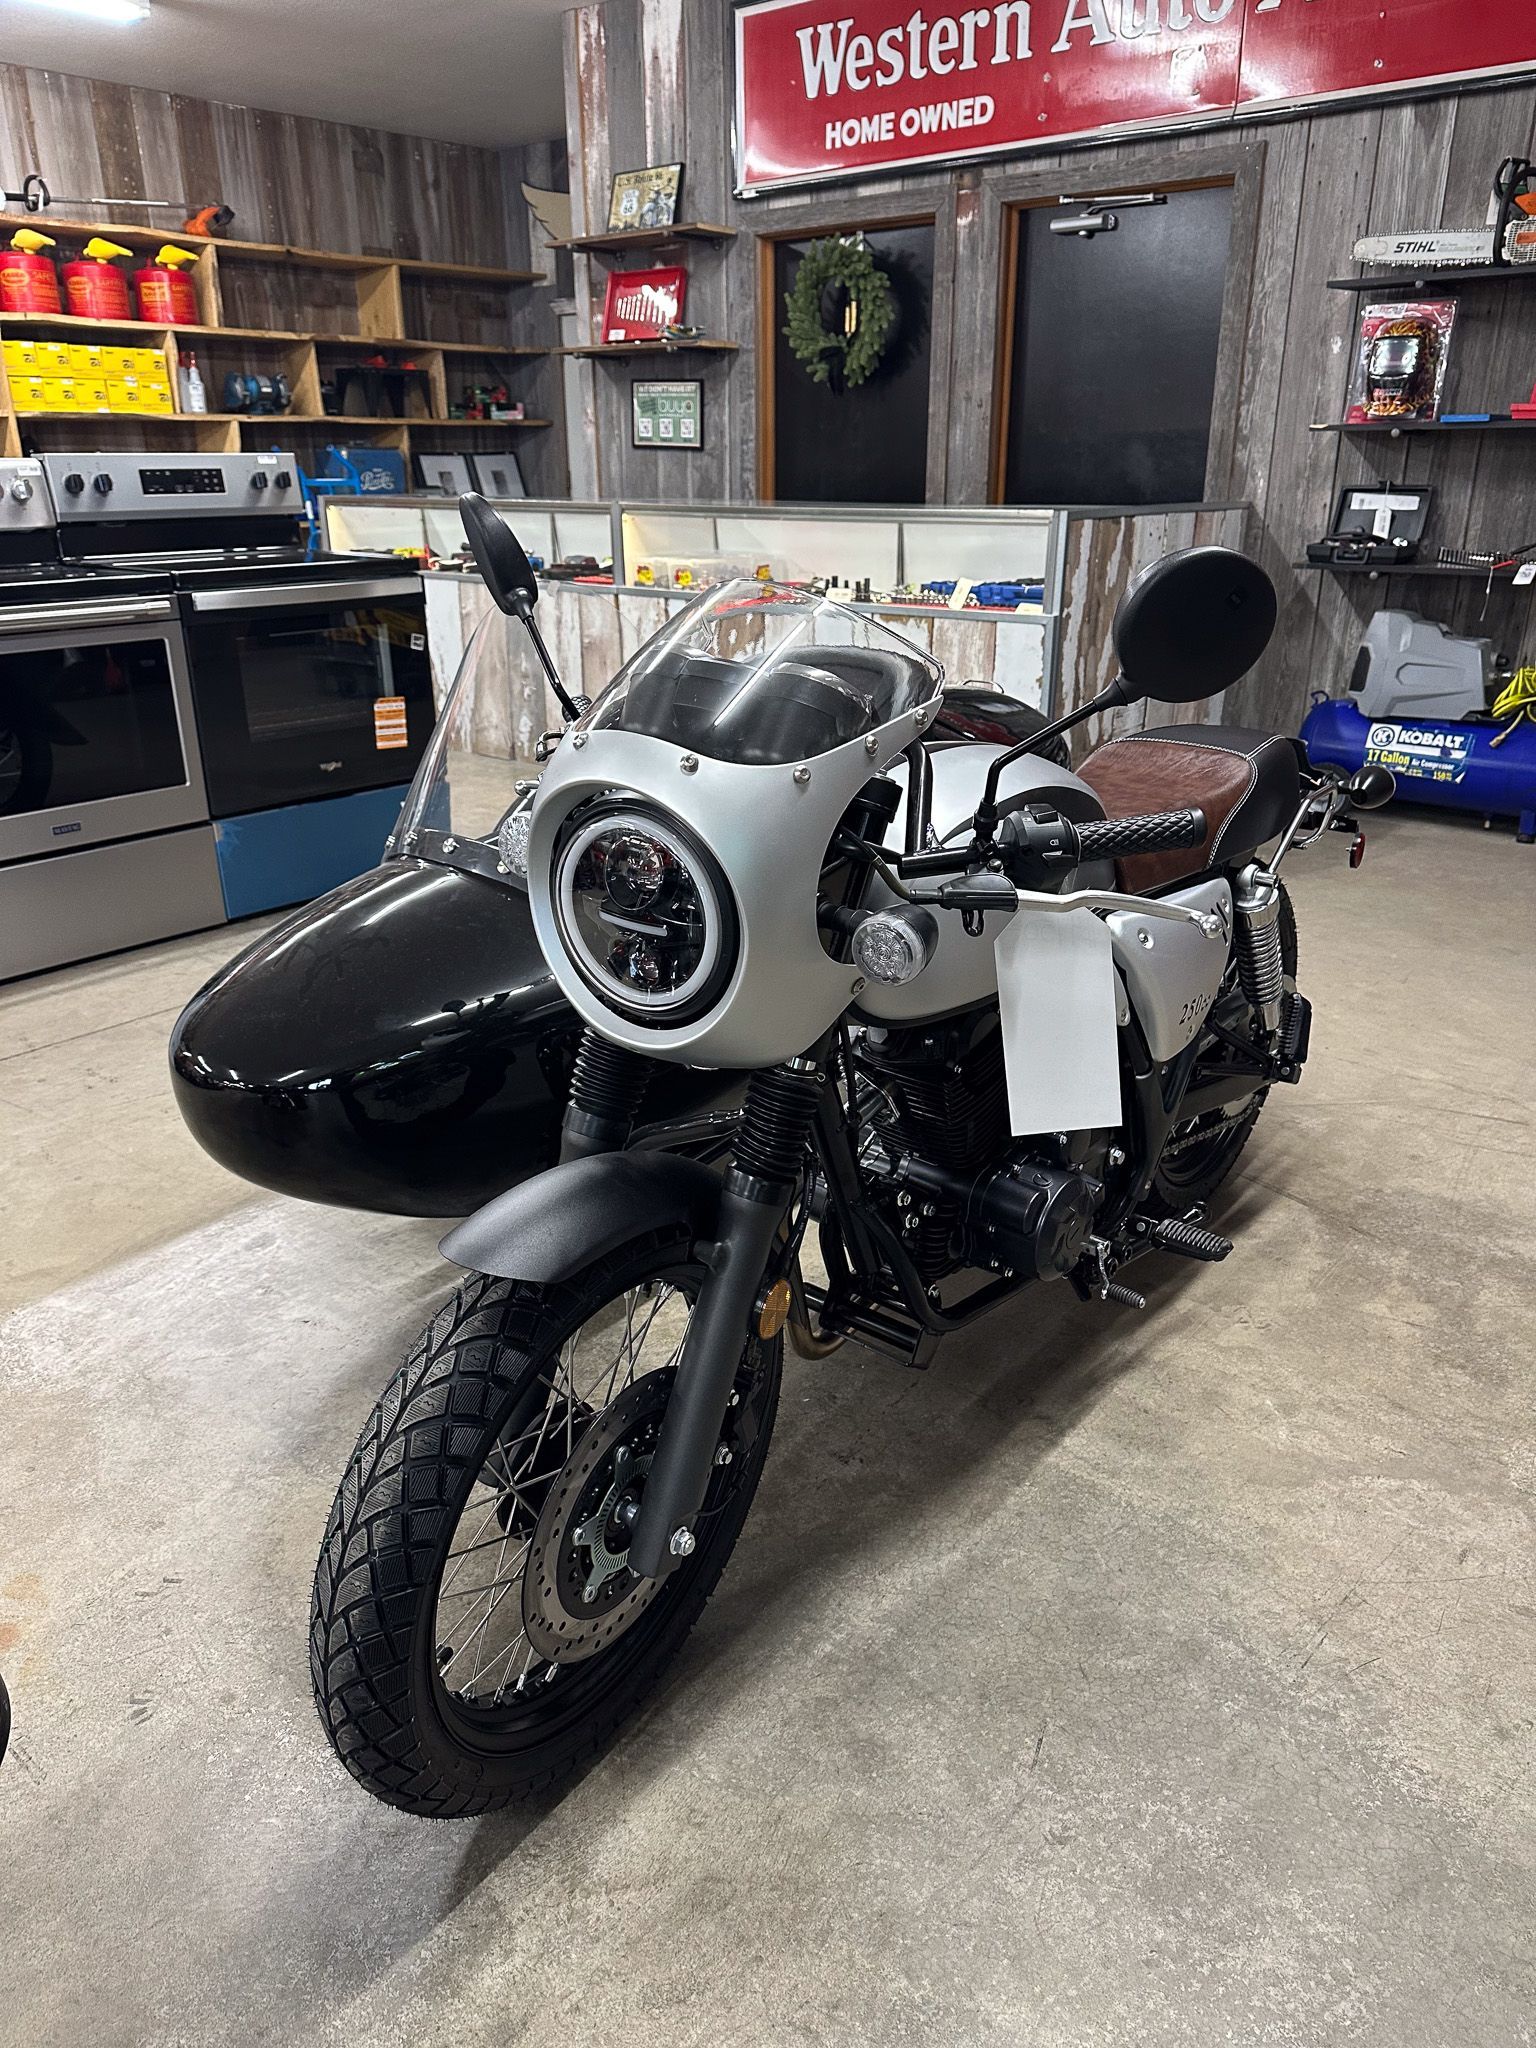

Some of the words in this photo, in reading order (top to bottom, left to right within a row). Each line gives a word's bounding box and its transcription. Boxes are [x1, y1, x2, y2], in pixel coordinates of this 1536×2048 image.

[795, 0, 1033, 99] Western
[825, 112, 895, 150] HOME
[899, 94, 995, 137] OWNED
[1394, 240, 1437, 254] STIHL
[1398, 730, 1465, 749] KOBALT
[1367, 749, 1380, 762] 17
[1380, 750, 1410, 765] Gallon
[1411, 758, 1420, 766] Air
[1421, 759, 1455, 771] Compressor
